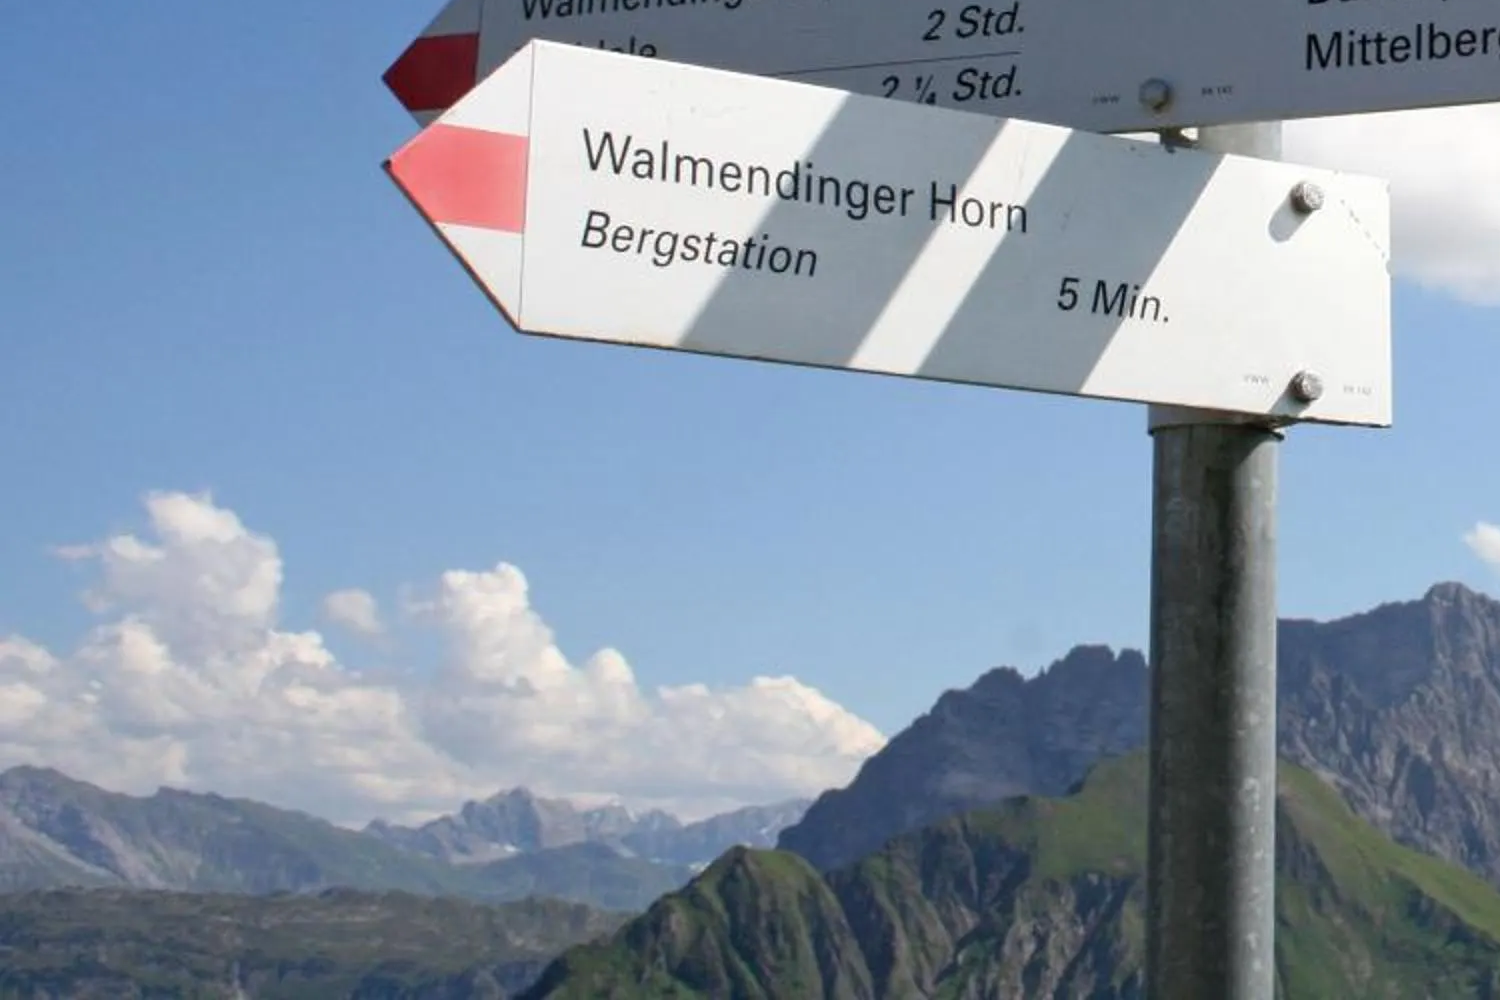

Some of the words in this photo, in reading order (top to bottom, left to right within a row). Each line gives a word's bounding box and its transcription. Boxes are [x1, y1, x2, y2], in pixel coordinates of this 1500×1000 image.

[955, 1, 1024, 39] Std.
[952, 64, 1022, 103] Std.
[582, 127, 916, 221] Walmendinger
[929, 180, 1028, 234] Horn
[580, 209, 818, 278] Bergstation
[1091, 279, 1170, 325] Min.
